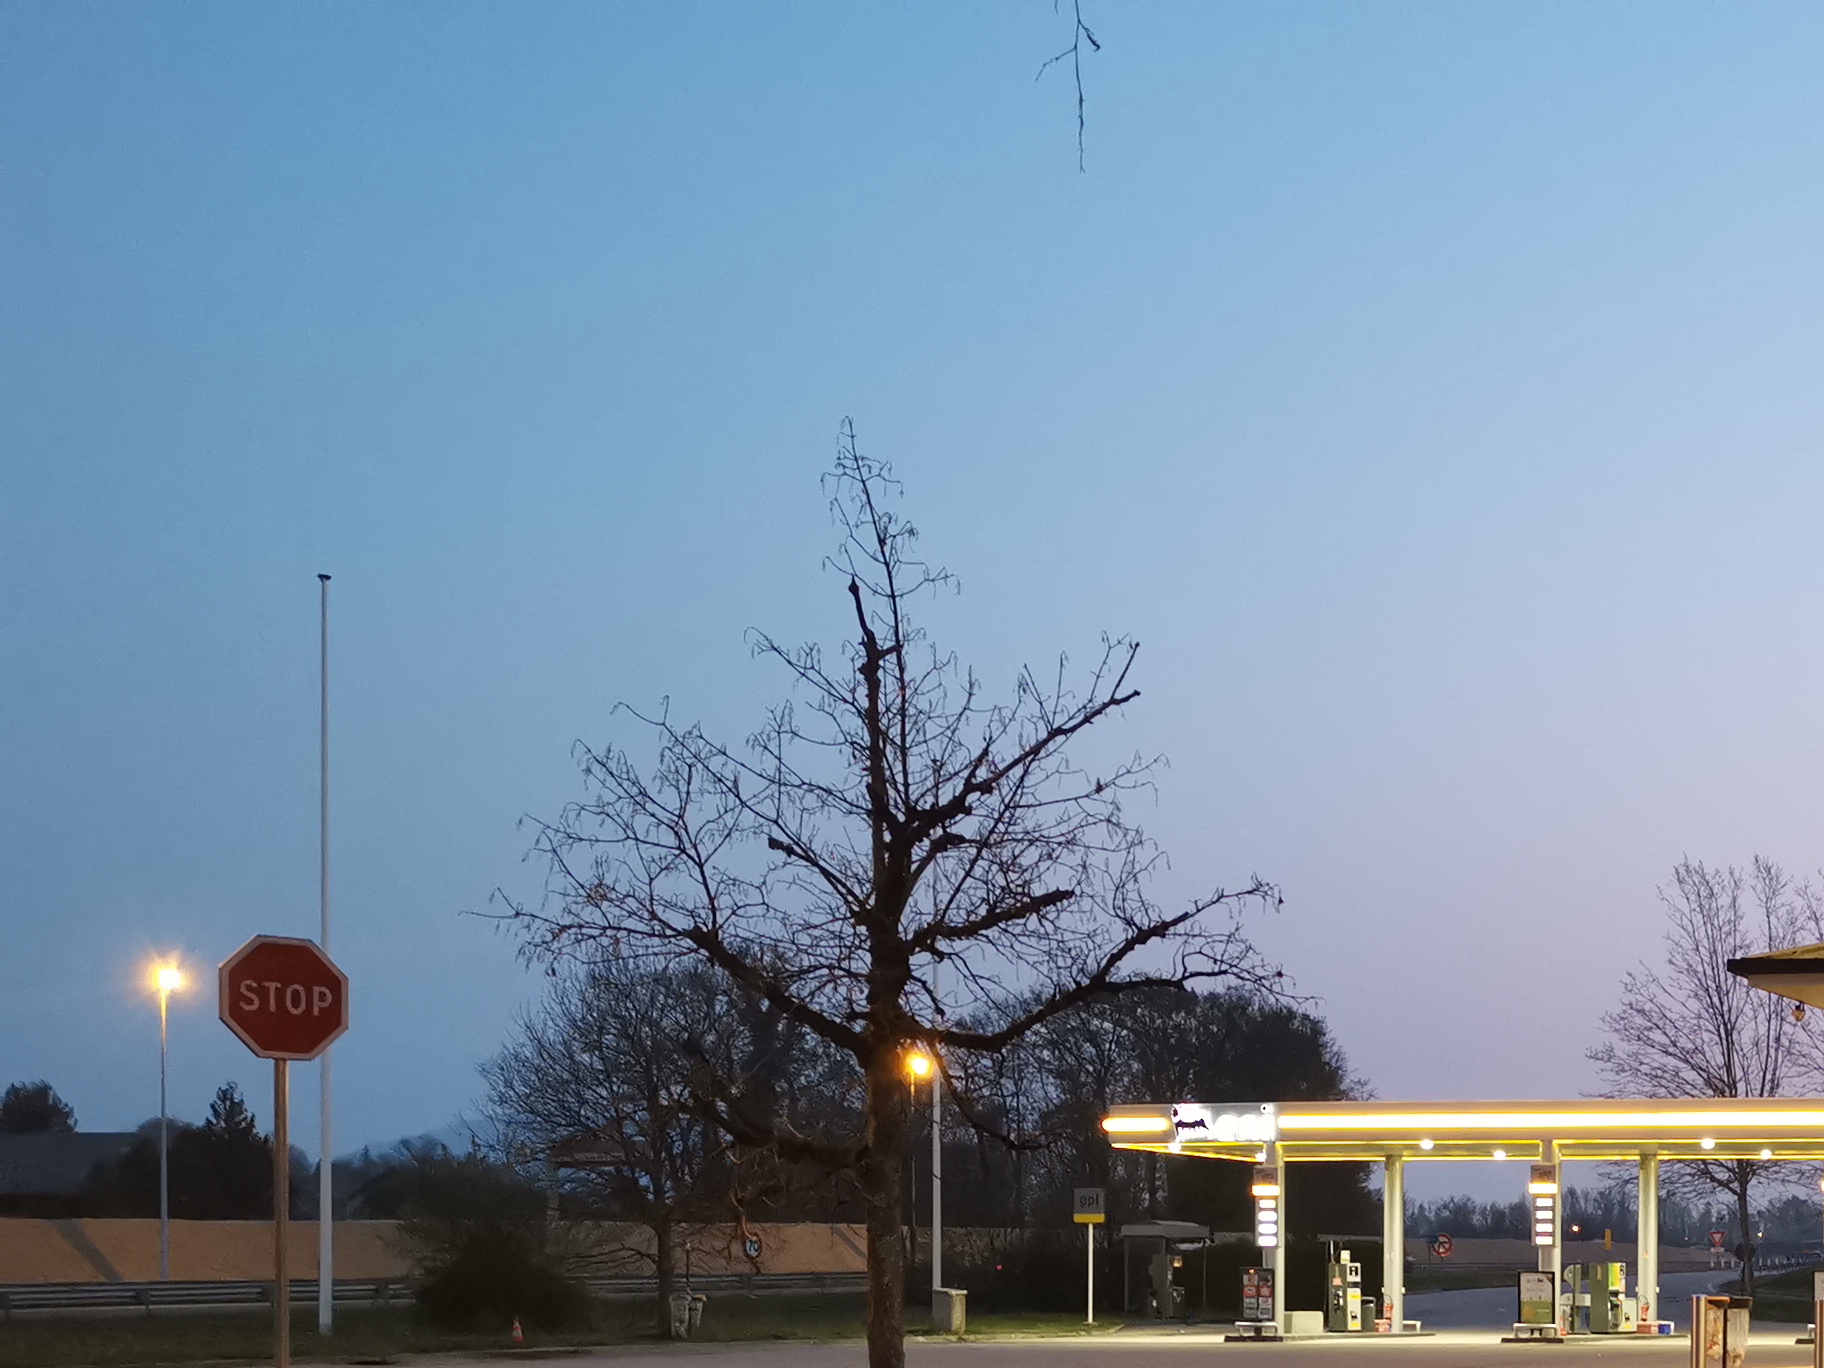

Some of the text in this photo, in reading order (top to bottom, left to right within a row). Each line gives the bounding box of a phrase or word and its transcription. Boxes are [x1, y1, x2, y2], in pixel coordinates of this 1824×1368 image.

[238, 979, 333, 1017] STOP
[1079, 1193, 1100, 1208] gpl
[748, 1239, 760, 1252] 70
